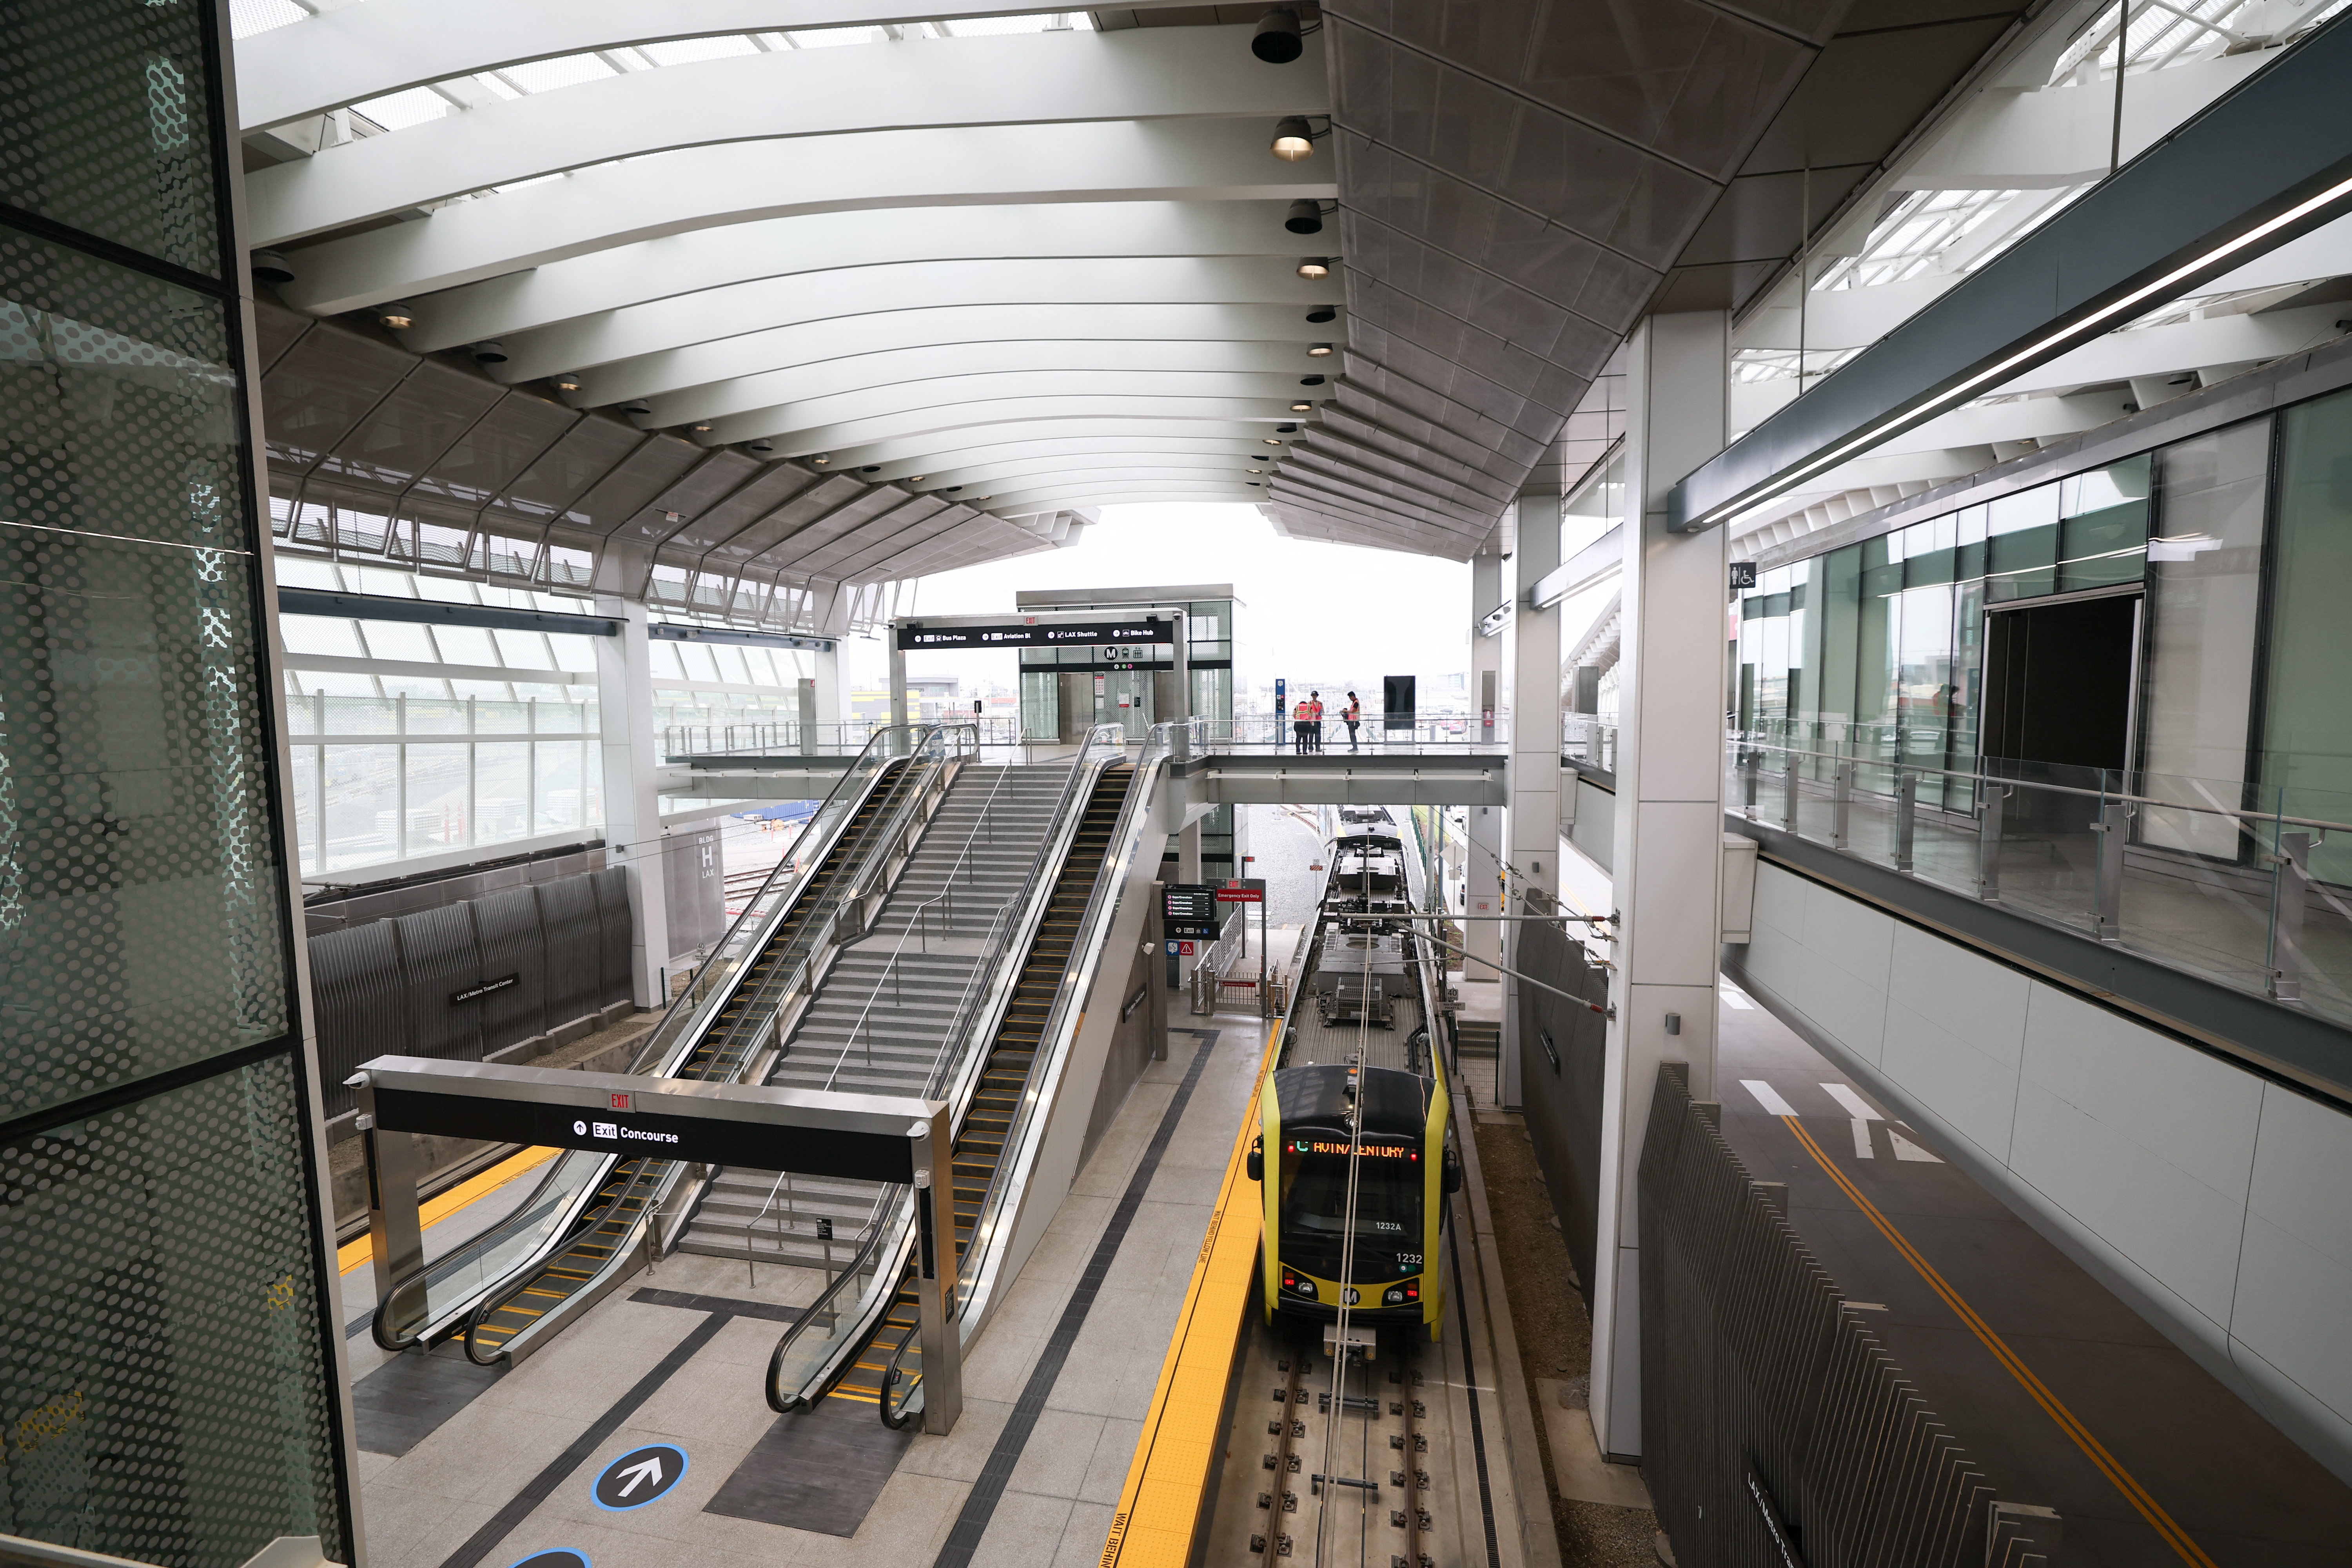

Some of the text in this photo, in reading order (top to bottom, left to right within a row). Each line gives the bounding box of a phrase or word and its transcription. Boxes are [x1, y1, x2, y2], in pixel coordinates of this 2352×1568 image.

[699, 835, 713, 844] BLDG
[702, 846, 712, 867] H
[702, 869, 714, 878] LAX
[457, 989, 483, 1000] LAX/Metro
[483, 984, 499, 992] Transit
[612, 1094, 629, 1108] EXIT
[595, 1125, 679, 1143] Exit Concourse
[516, 1165, 537, 1177] BEHIND
[537, 1153, 559, 1165] YELLOW
[1208, 1220, 1218, 1235] BEHIND
[1376, 1222, 1401, 1230] 1232A
[1202, 1236, 1214, 1253] YELLOW
[1199, 1254, 1207, 1263] LINE
[1396, 1253, 1422, 1264] 1232
[1748, 1472, 1779, 1544] LAX/Metro
[1100, 1514, 1127, 1568] WAIT BEHIN
